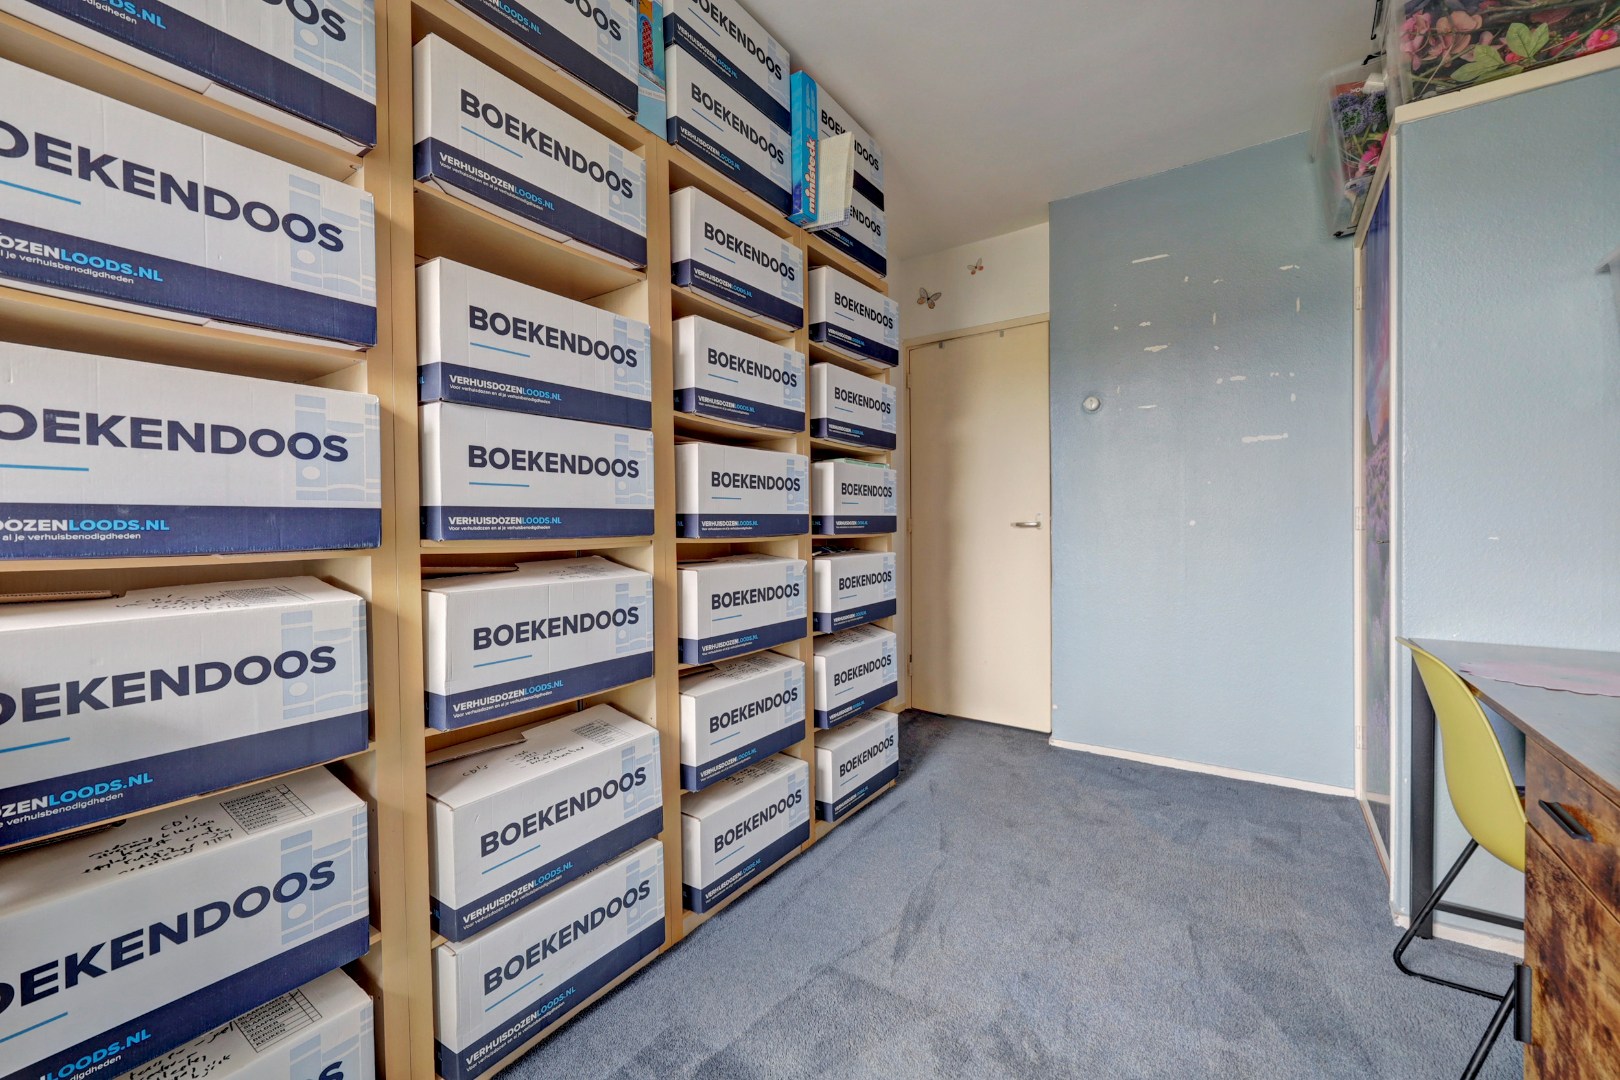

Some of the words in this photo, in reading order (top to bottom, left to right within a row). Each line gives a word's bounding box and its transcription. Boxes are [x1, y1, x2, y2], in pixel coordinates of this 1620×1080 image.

[262, 0, 347, 41] OS
[564, 0, 622, 41] OOS
[692, 0, 782, 80] OEKENDOOS
[460, 88, 633, 199] BOEKENDOOS
[691, 83, 784, 165] BOEKENDOOS
[821, 109, 880, 171] BOEKDOOS
[439, 152, 555, 211] VERHUISDOZENLOODS.NL
[805, 137, 817, 214] ministeck
[849, 204, 881, 237] NDOOS
[0, 233, 164, 282] OZENLOODS.NL
[6, 251, 16, 260] je
[19, 255, 134, 284] verhuisbenodigdheden
[704, 221, 795, 281] BOEKENDOOS
[834, 291, 893, 330] BOEKENDOOS
[469, 305, 638, 368] BOEKENDOOS
[449, 374, 562, 401] VERHUISDOZENLOODS.NL
[708, 348, 798, 388] BOEKENDOOS
[834, 387, 891, 415] BOEKENDOOS
[468, 445, 639, 478] BOEKENDOOS
[711, 471, 800, 492] BOEKENDOOS
[841, 483, 892, 498] BOEKENDOOS
[0, 519, 170, 532] OZENLOODS.NL
[14, 533, 25, 542] je
[27, 532, 141, 541] verhuisbenodigdheden
[448, 516, 562, 525] VERHUISDOZENLOODS.NL
[711, 583, 800, 610] BOEKENDOOS
[838, 571, 892, 591] BOEKENDOOS
[473, 606, 639, 650] BOEKENDOOS
[834, 655, 892, 687] BOEKENDOOS
[452, 680, 563, 712] VERHUISDOZENLOODS.NL
[709, 687, 798, 733] BOEKENDOOS
[839, 734, 894, 777] BOEKENDOOS
[0, 772, 154, 818] ZENLOODS.NL
[6, 792, 124, 826] verhuisbenodigdheden
[480, 766, 646, 857] BOEKENDOOS
[714, 789, 802, 853] BOEKENDOOS
[462, 861, 573, 923] VERHUISDOZENLOODS.NL
[484, 879, 650, 996] BOEKENDOOS
[466, 986, 576, 1065] VERHUISDOZENLOODS.NL
